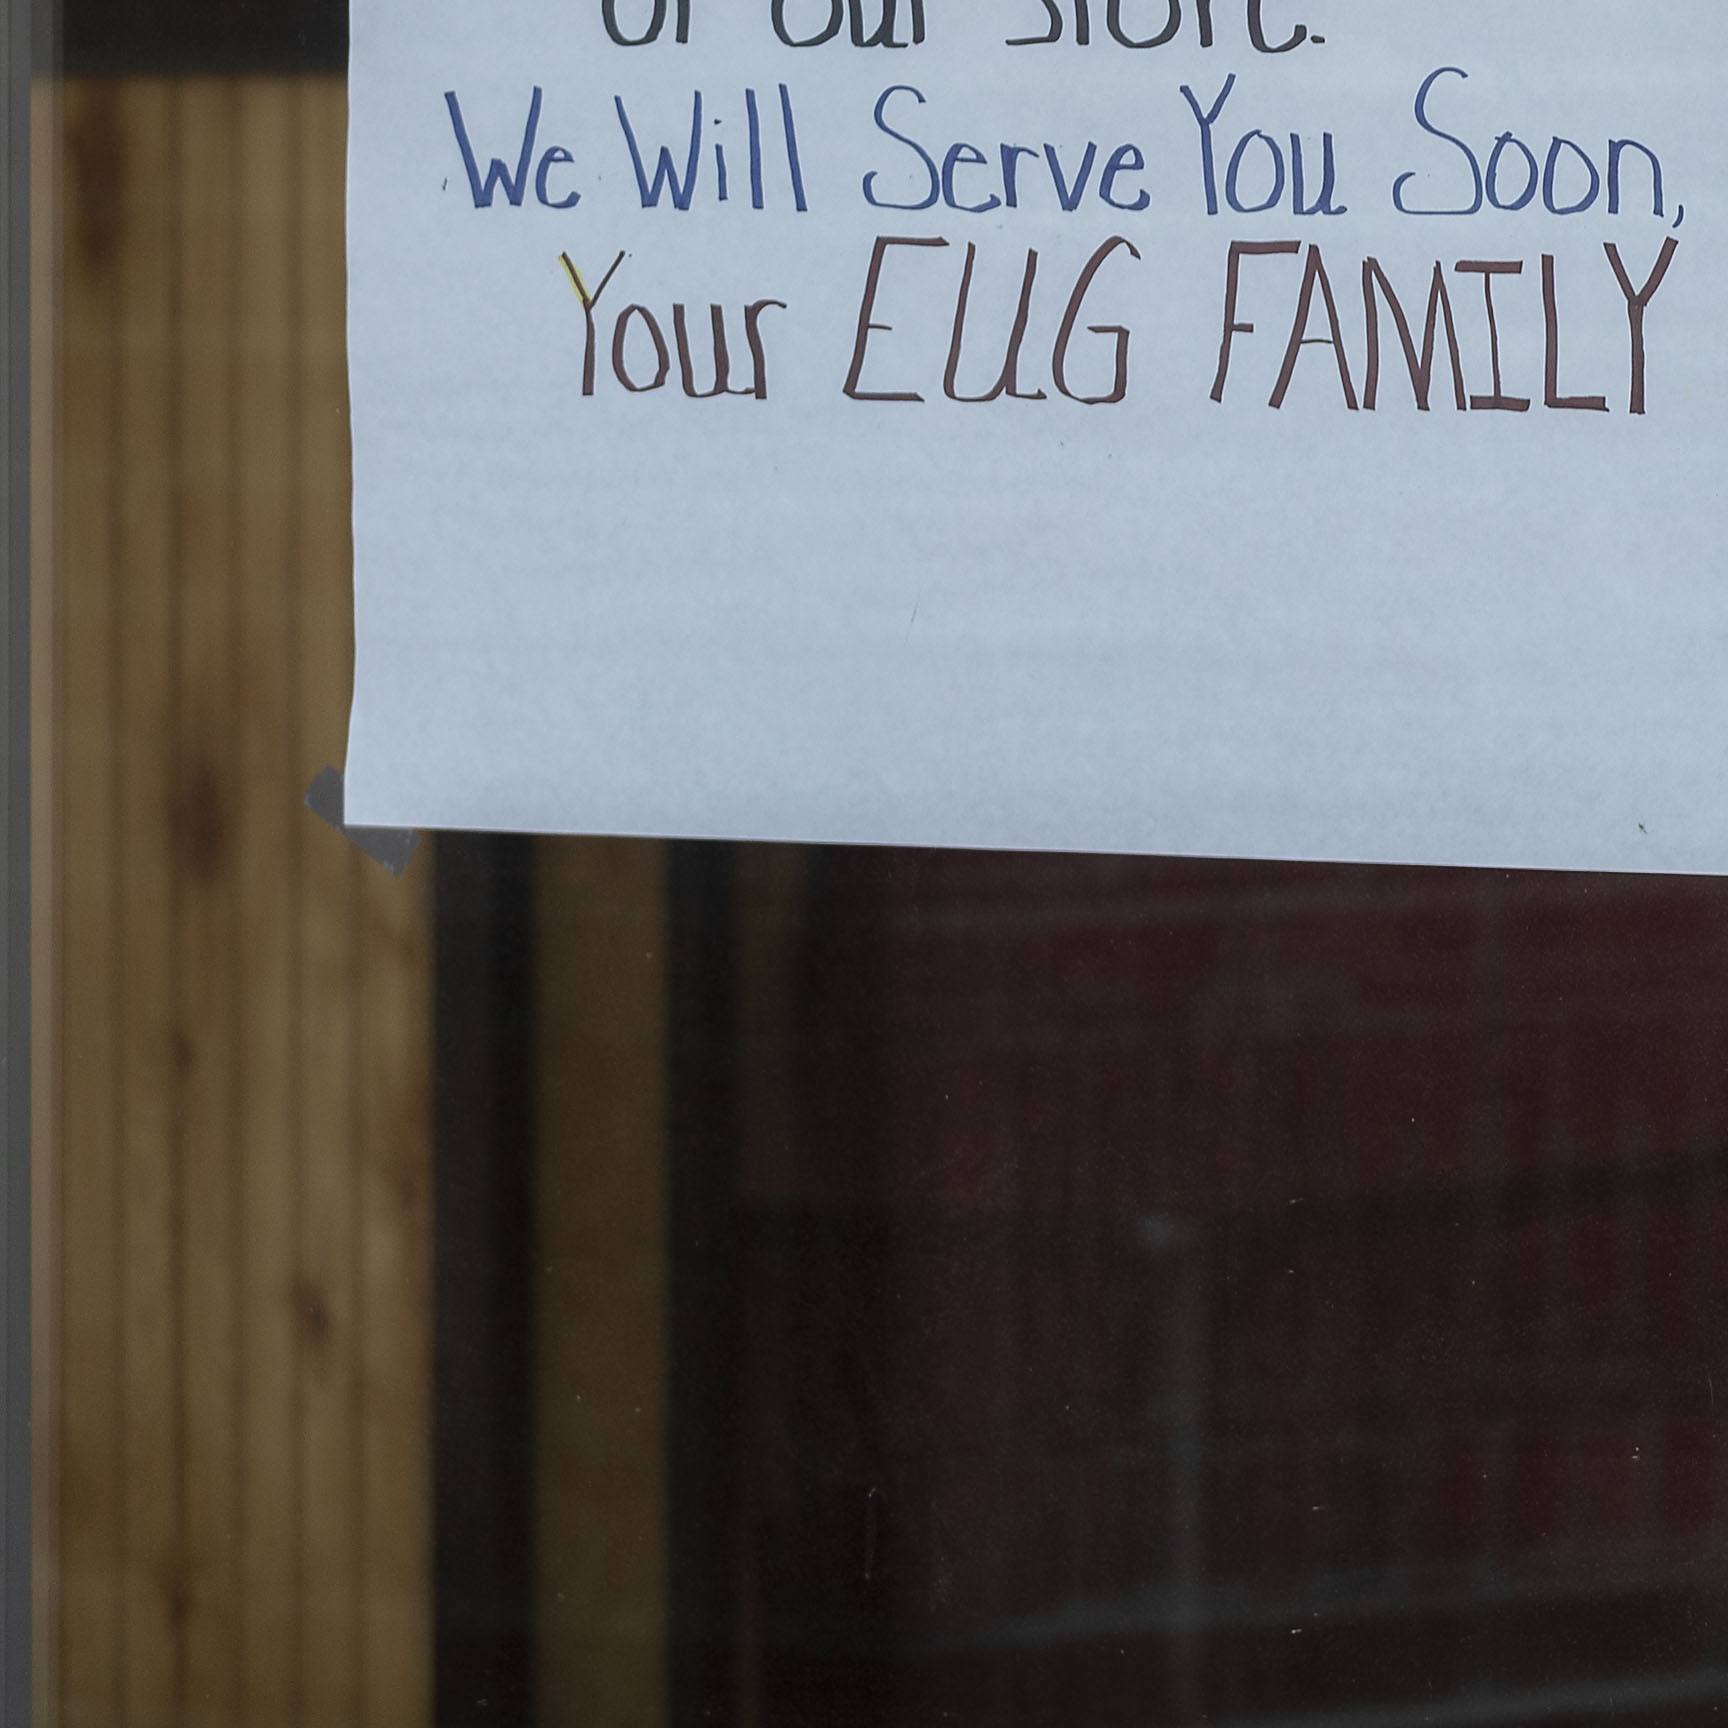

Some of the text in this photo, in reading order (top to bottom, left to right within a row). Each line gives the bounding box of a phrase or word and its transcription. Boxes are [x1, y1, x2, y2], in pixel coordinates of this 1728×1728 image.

[442, 67, 1683, 228] We Will Serve You Soon,
[561, 236, 1679, 415] Your EUG FAMILY
